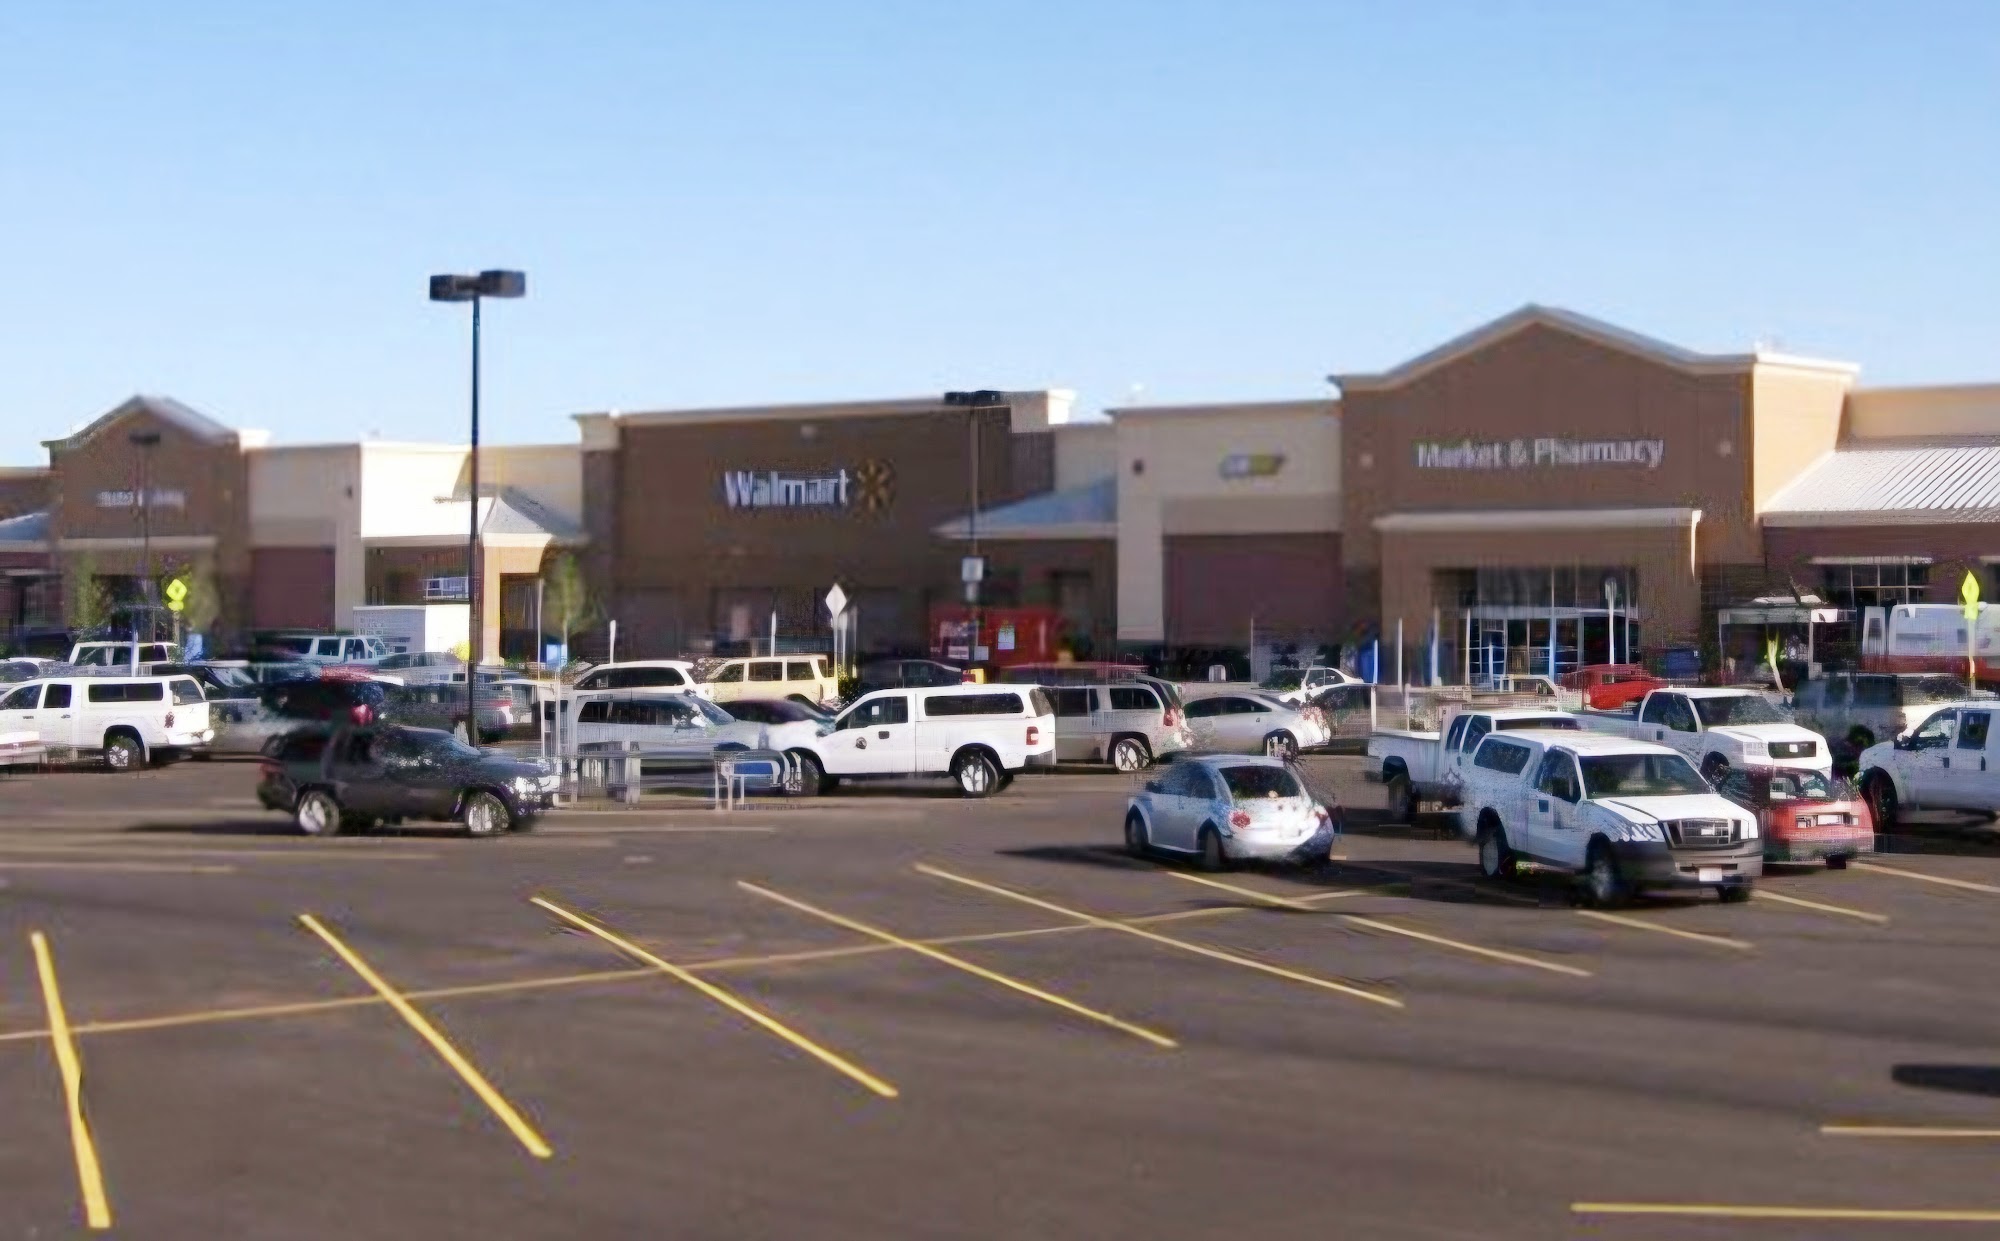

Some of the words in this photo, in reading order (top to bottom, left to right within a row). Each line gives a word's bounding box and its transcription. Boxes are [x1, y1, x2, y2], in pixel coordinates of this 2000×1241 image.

[1418, 440, 1502, 468] Market
[1534, 438, 1664, 467] Pharmacy
[724, 469, 850, 508] Walmart
